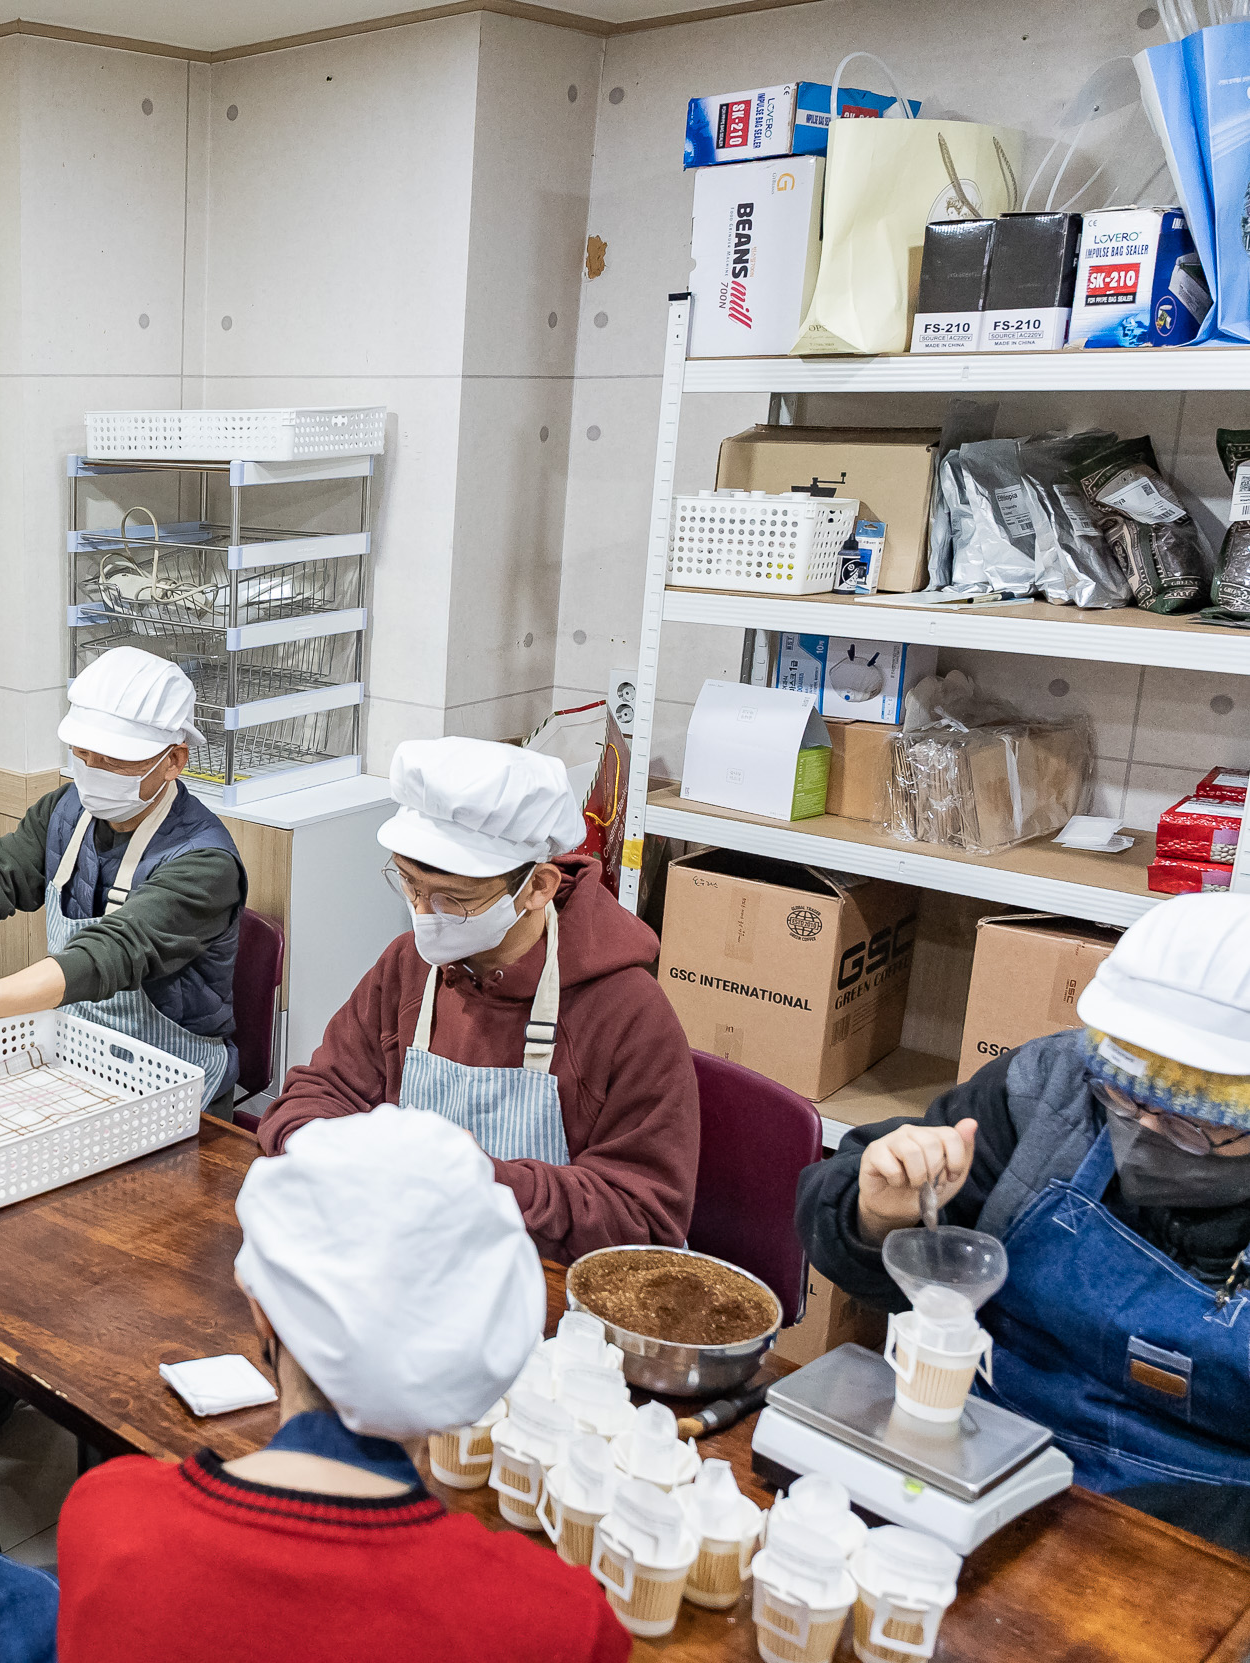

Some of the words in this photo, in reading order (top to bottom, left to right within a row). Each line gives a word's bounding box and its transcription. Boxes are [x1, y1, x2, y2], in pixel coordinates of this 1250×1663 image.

[756, 93, 765, 115] IMPULSE
[729, 103, 745, 145] SK-210
[755, 115, 763, 128] BAG
[765, 98, 775, 139] LOVERO
[753, 128, 762, 149] SEALER
[777, 173, 795, 191] G
[731, 202, 754, 279] BEANS
[1094, 231, 1138, 244] LOVERO
[1085, 246, 1109, 259] IMPULSE
[1110, 245, 1124, 257] BAG
[1125, 244, 1149, 256] SEALER
[1090, 270, 1136, 289] SK-210
[719, 282, 729, 309] 700N
[728, 280, 753, 329] mill
[924, 322, 971, 333] FS-210
[993, 319, 1041, 331] FS-210
[837, 914, 916, 990] GSC
[669, 967, 697, 983] GSC
[699, 974, 812, 1011] INTERNATIONAL
[835, 980, 871, 1010] GREEN
[1066, 979, 1077, 1004] GSC
